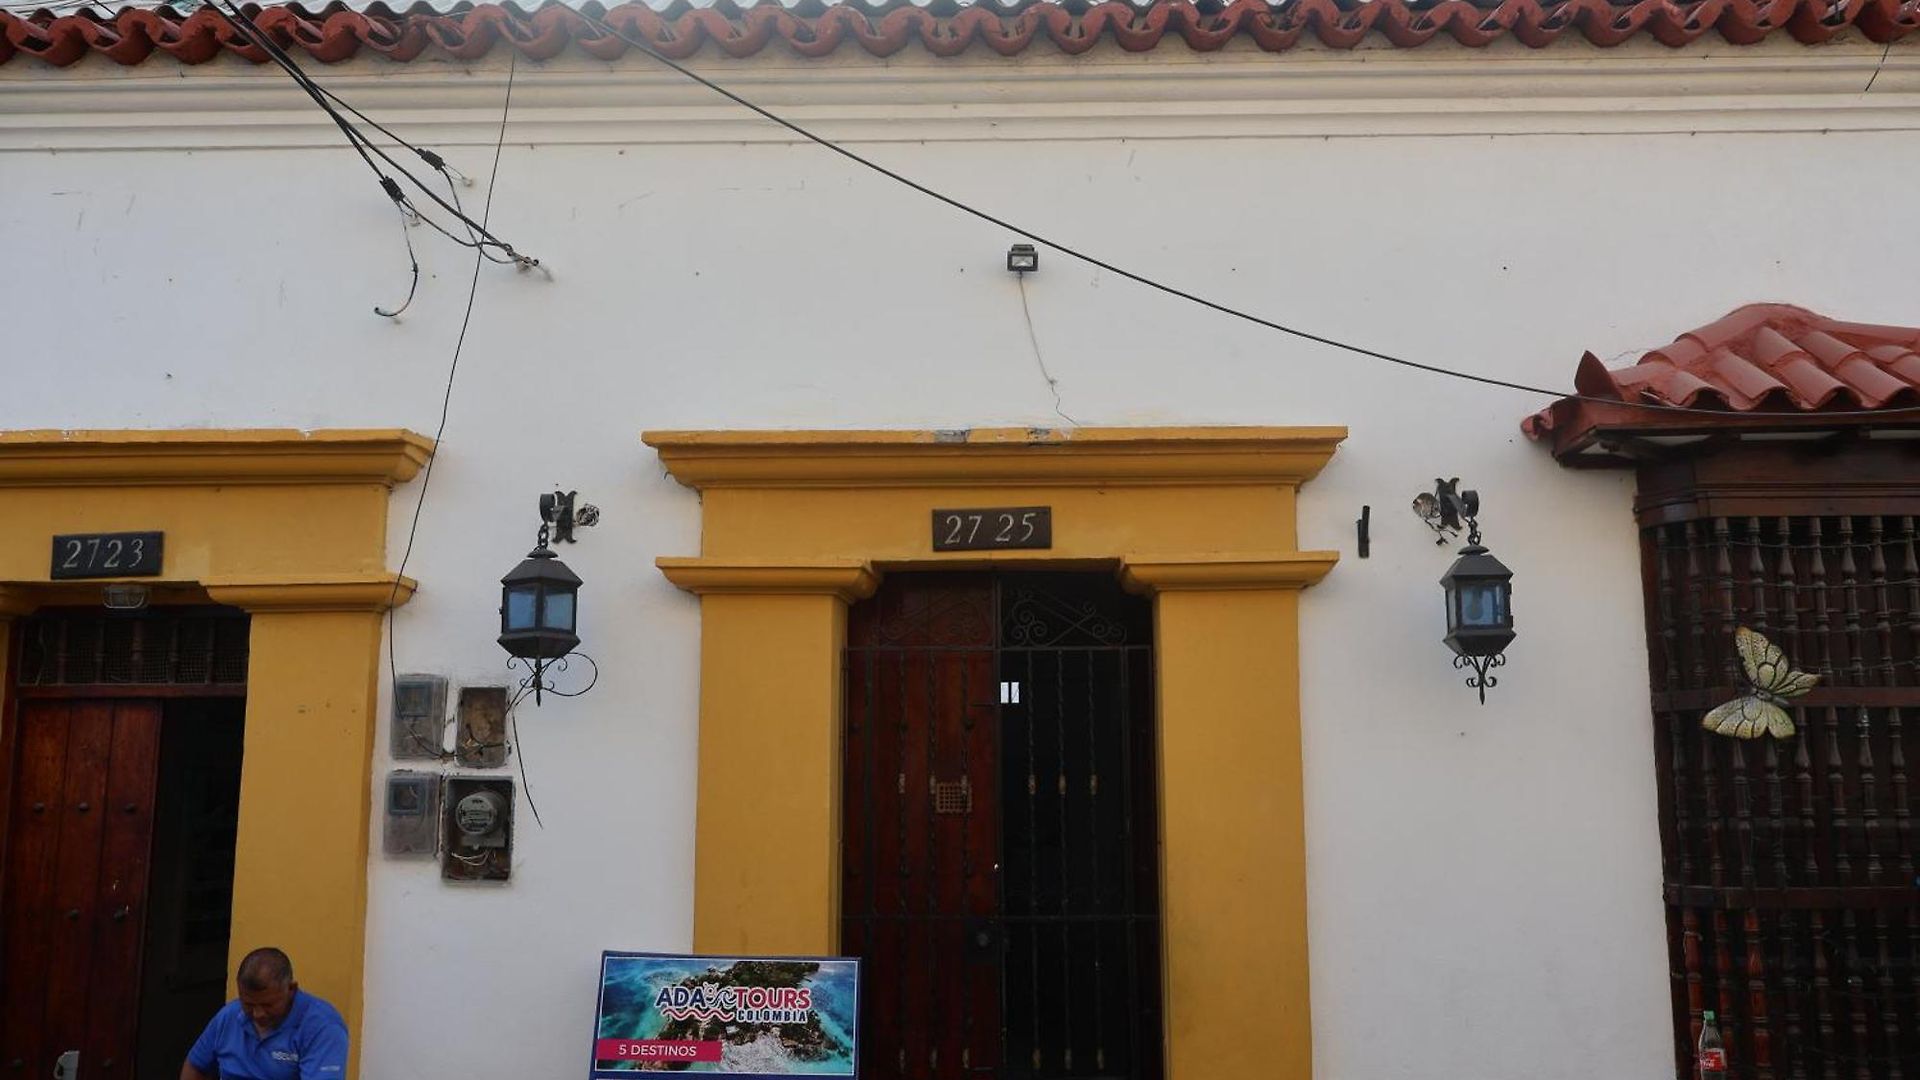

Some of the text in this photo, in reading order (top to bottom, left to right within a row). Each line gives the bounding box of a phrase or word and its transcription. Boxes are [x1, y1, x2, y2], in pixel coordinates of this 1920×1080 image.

[62, 538, 145, 569] 2723
[655, 986, 812, 1010] ADA TOURS
[737, 1010, 808, 1023] COLOMBIA
[618, 1044, 698, 1057] 5 DESTINOS
